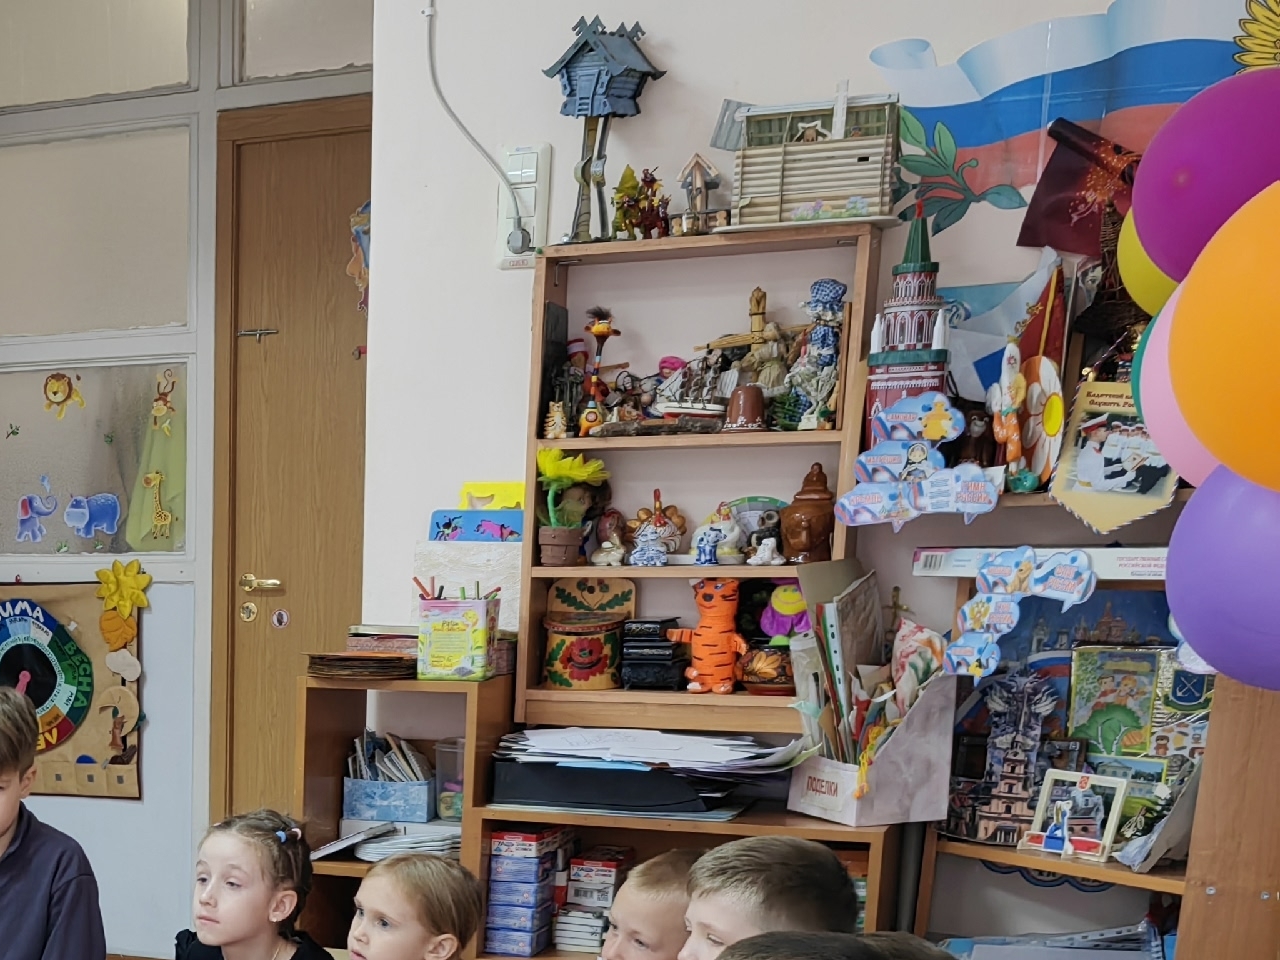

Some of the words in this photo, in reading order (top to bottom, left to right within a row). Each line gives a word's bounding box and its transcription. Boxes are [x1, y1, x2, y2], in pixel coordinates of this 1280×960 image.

[64, 641, 91, 708] ВЕСНА
[36, 728, 58, 750] ЛЕ
[807, 776, 838, 797] ПОДЕЛКИ
